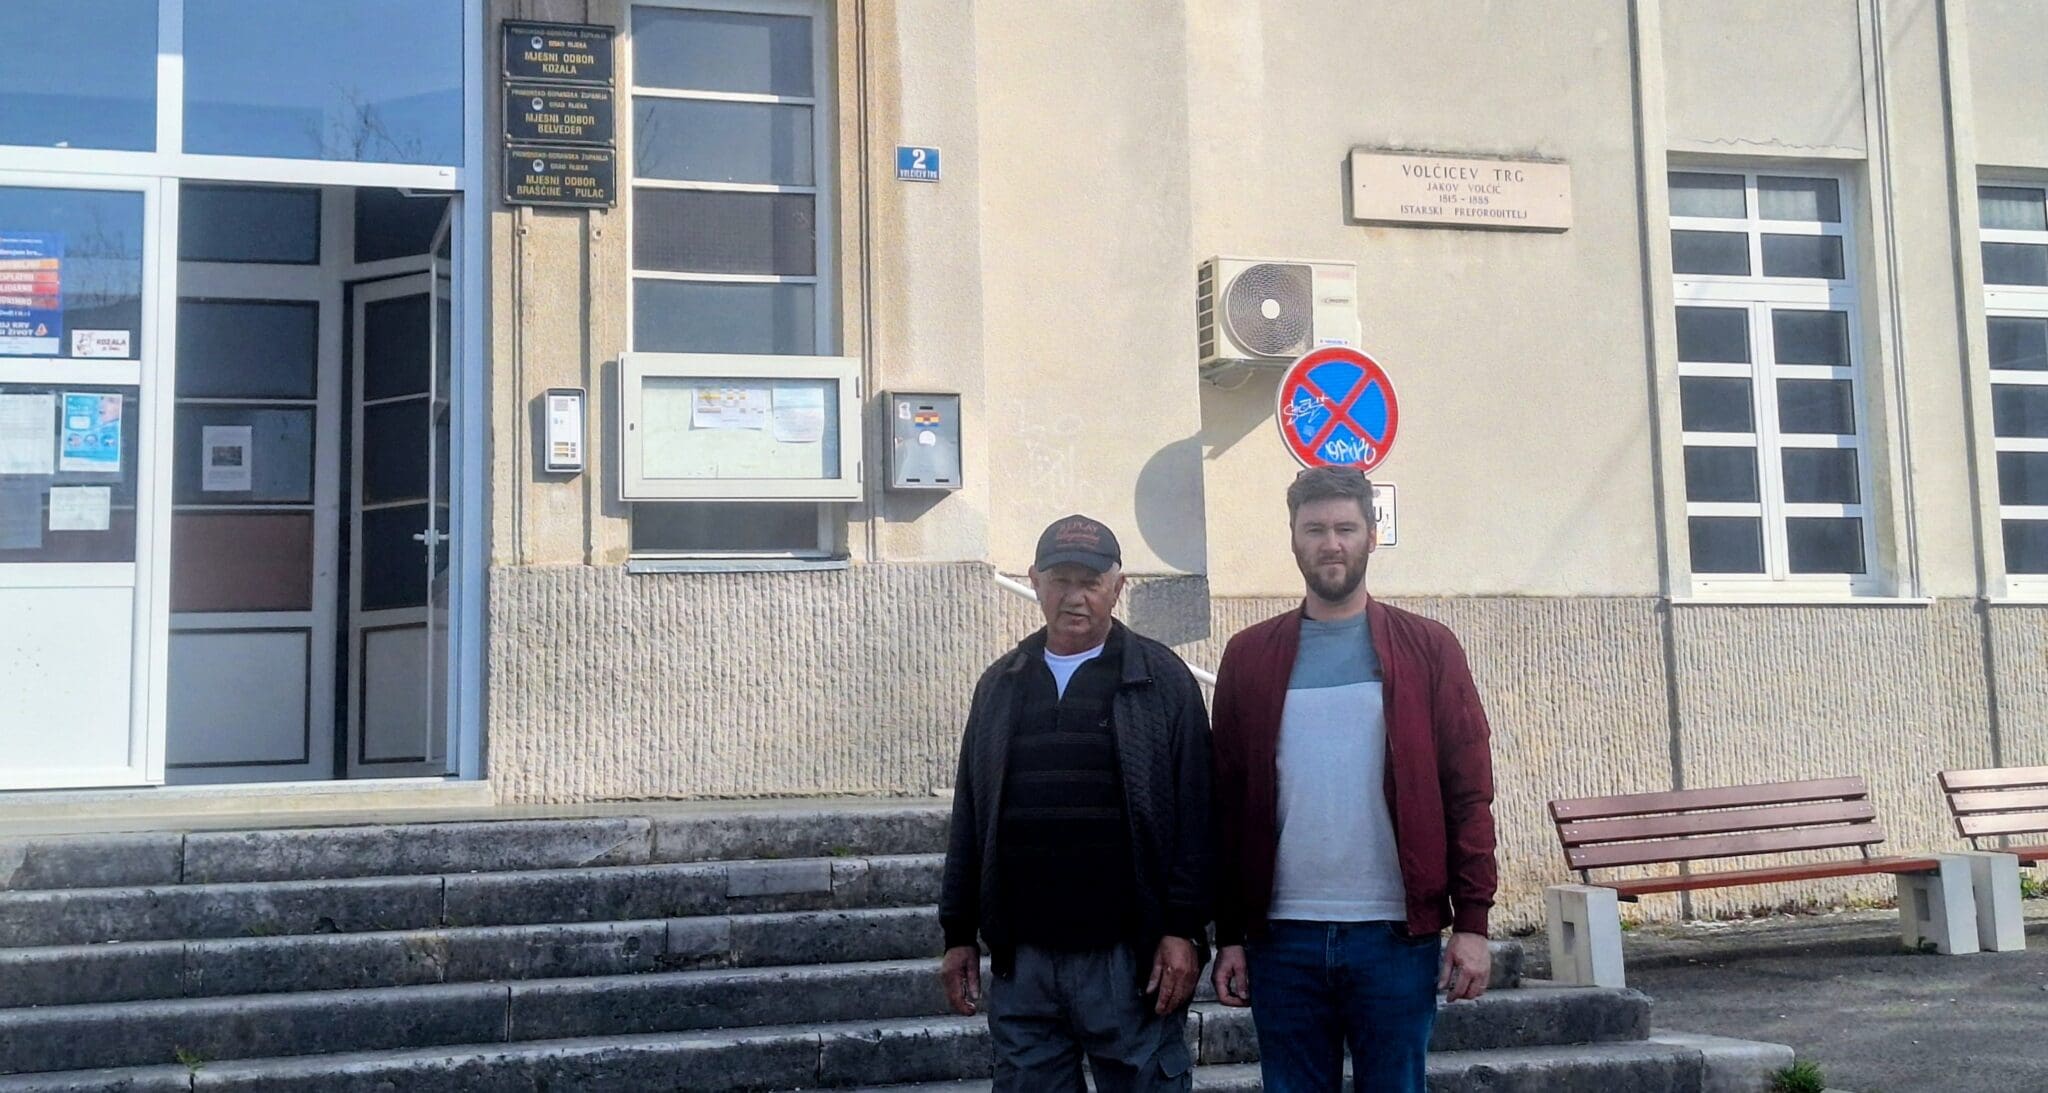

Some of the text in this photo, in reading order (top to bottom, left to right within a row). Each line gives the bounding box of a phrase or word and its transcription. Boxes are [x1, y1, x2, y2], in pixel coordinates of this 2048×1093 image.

[524, 51, 595, 64] MJESNI ODBOR
[542, 63, 577, 74] KOZALA
[525, 113, 595, 125] MJESNI ODBOR
[538, 124, 582, 135] BELVEDER
[912, 149, 926, 169] 2
[526, 174, 596, 187] MJESNI ODBOR
[1494, 168, 1524, 182] TRG
[1426, 182, 1459, 192] JAKOV
[575, 188, 604, 198] PULAC
[1439, 194, 1457, 203] 1815
[1400, 204, 1443, 215] ISTARSKI
